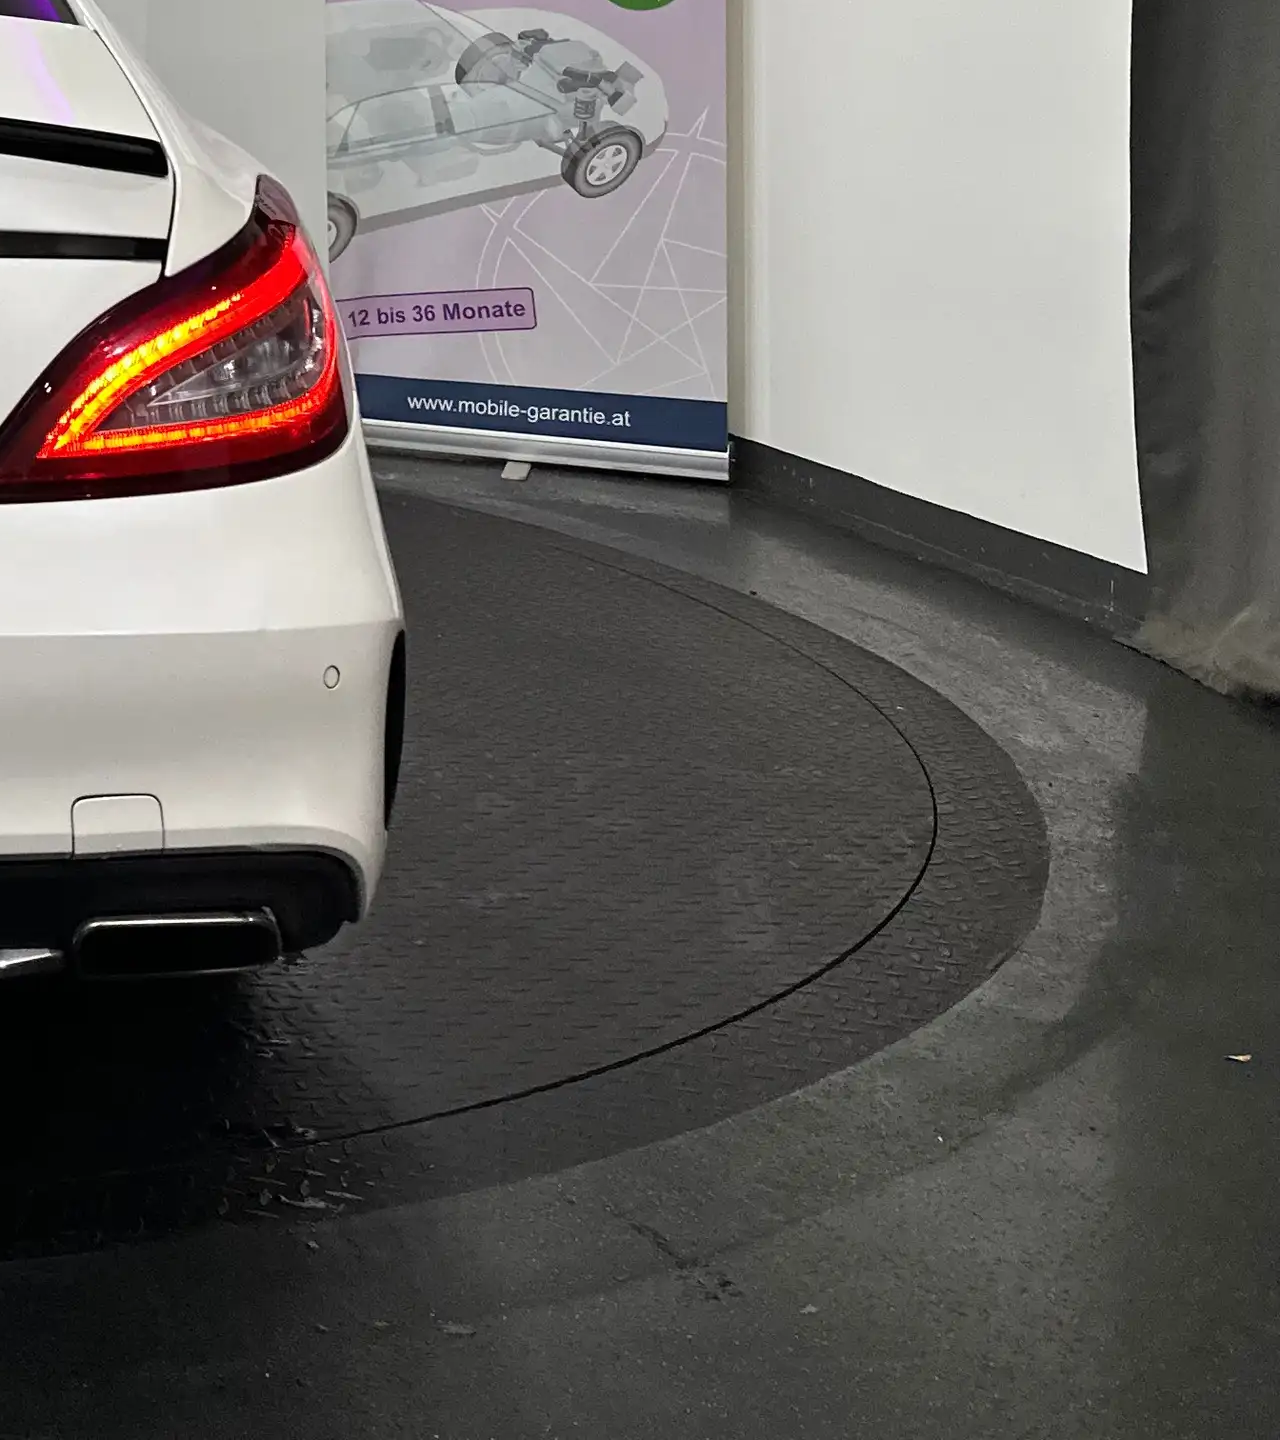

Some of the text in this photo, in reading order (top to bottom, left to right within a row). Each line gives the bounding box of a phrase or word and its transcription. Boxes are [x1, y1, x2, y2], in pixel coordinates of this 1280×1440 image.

[347, 300, 526, 328] 12 bis 36 Monate
[407, 395, 632, 428] www.mobile-garantie.at
